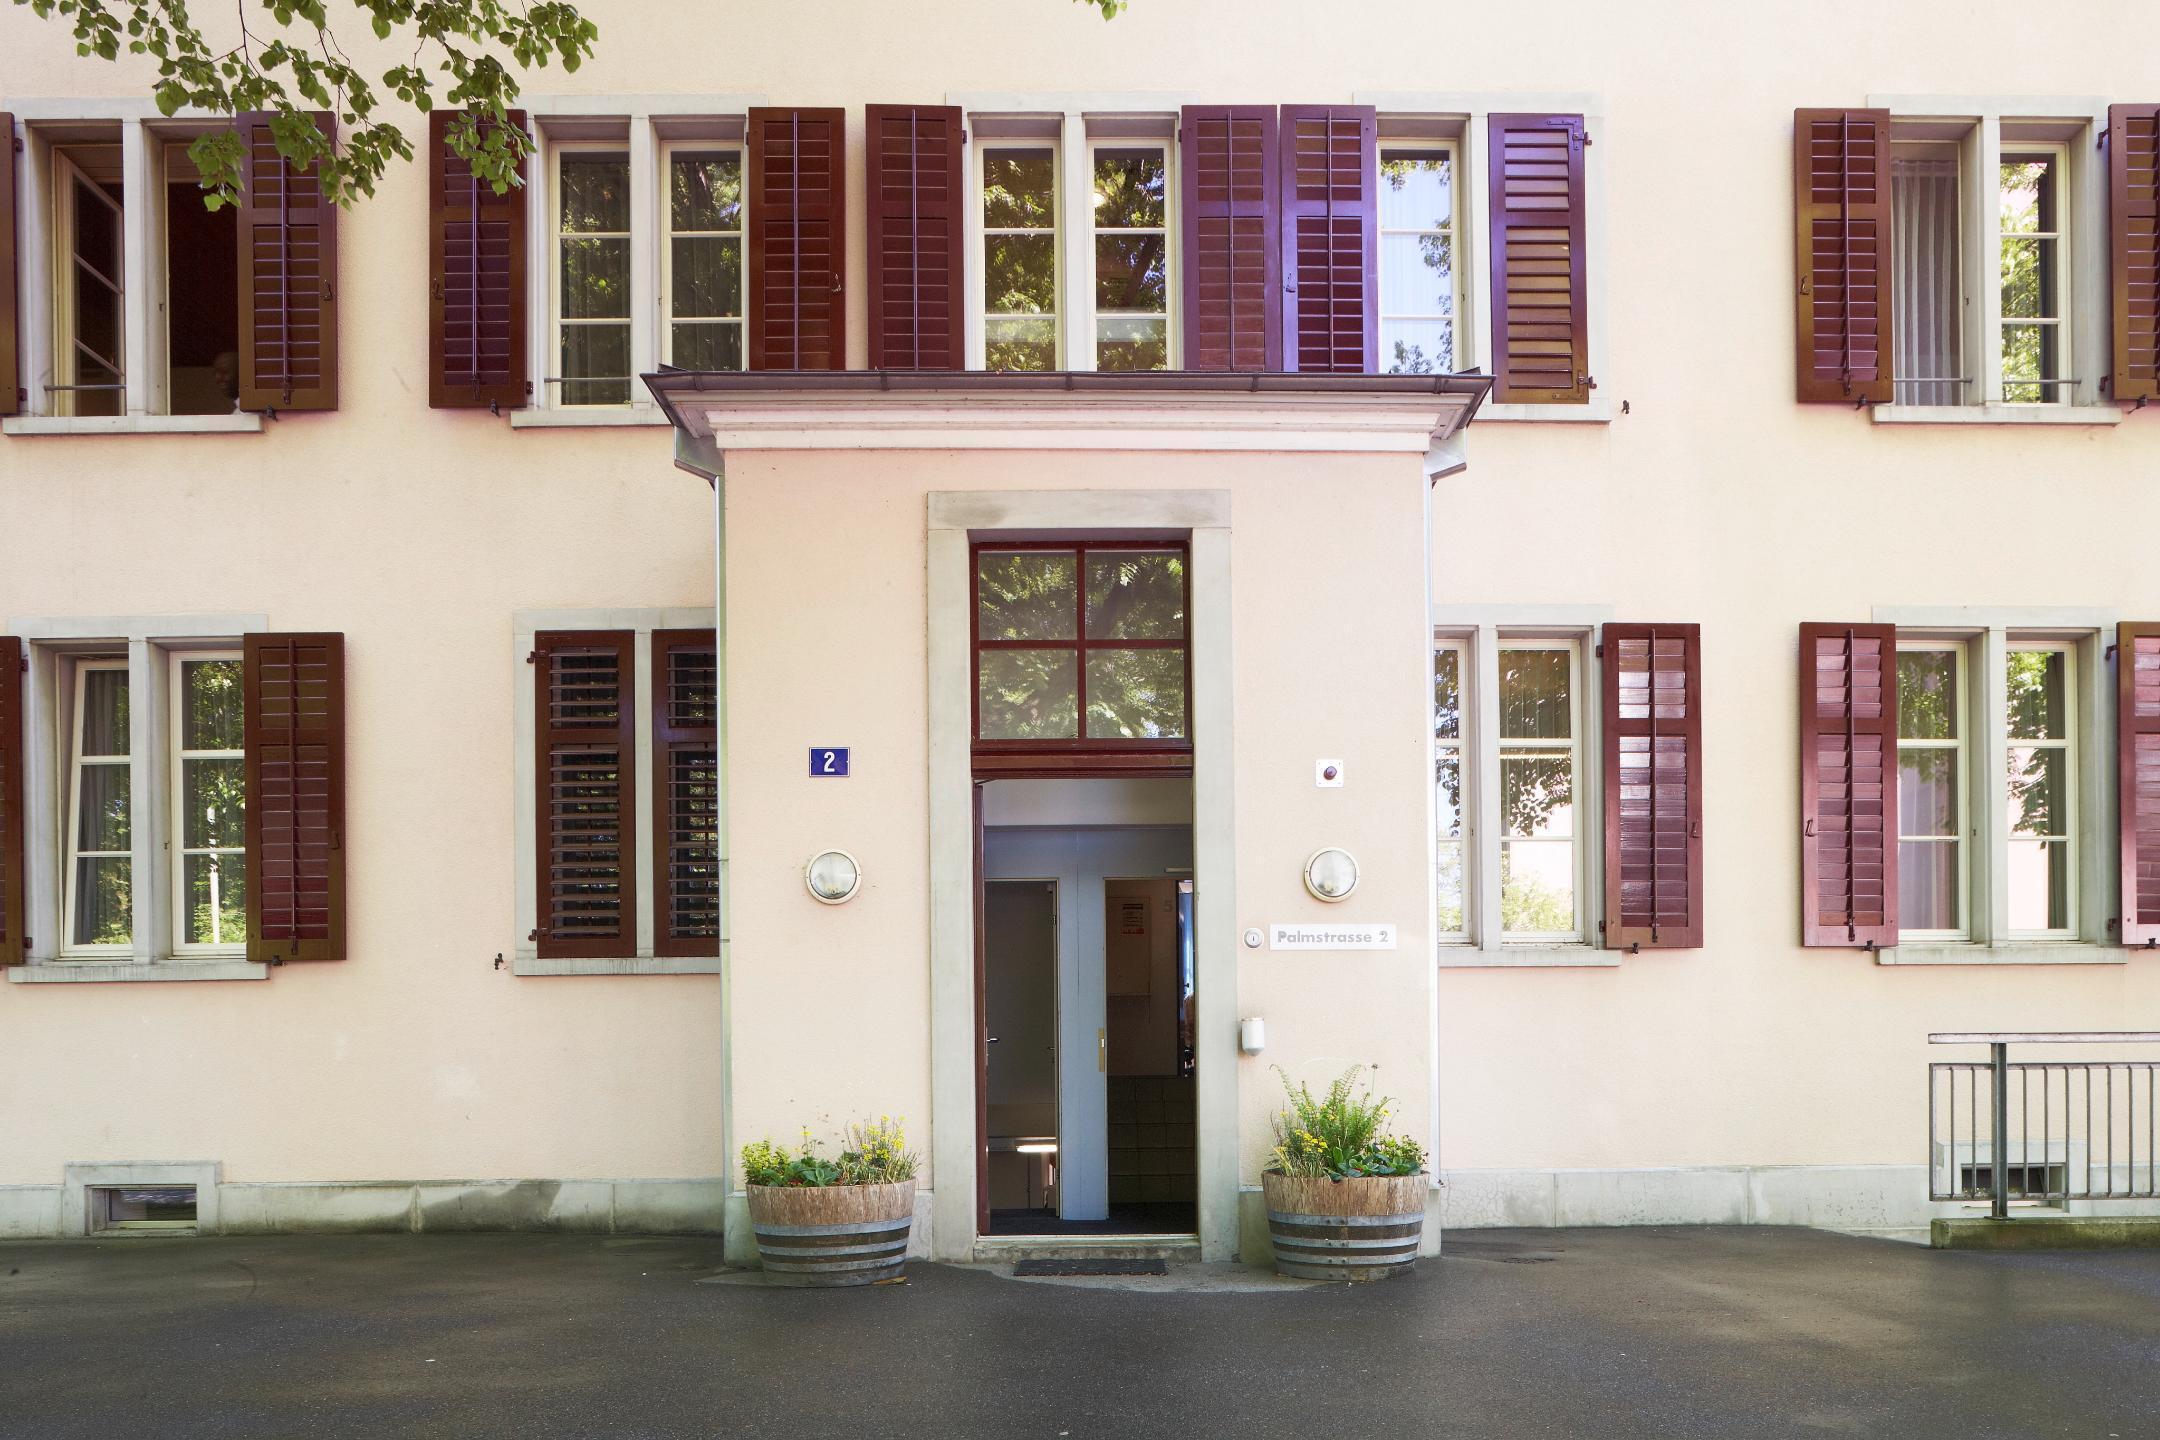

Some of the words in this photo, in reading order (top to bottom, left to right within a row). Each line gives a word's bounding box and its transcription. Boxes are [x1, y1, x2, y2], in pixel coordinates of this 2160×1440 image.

[823, 751, 835, 772] 2
[1277, 930, 1372, 943] Palmstrasse
[1378, 930, 1389, 942] 2
